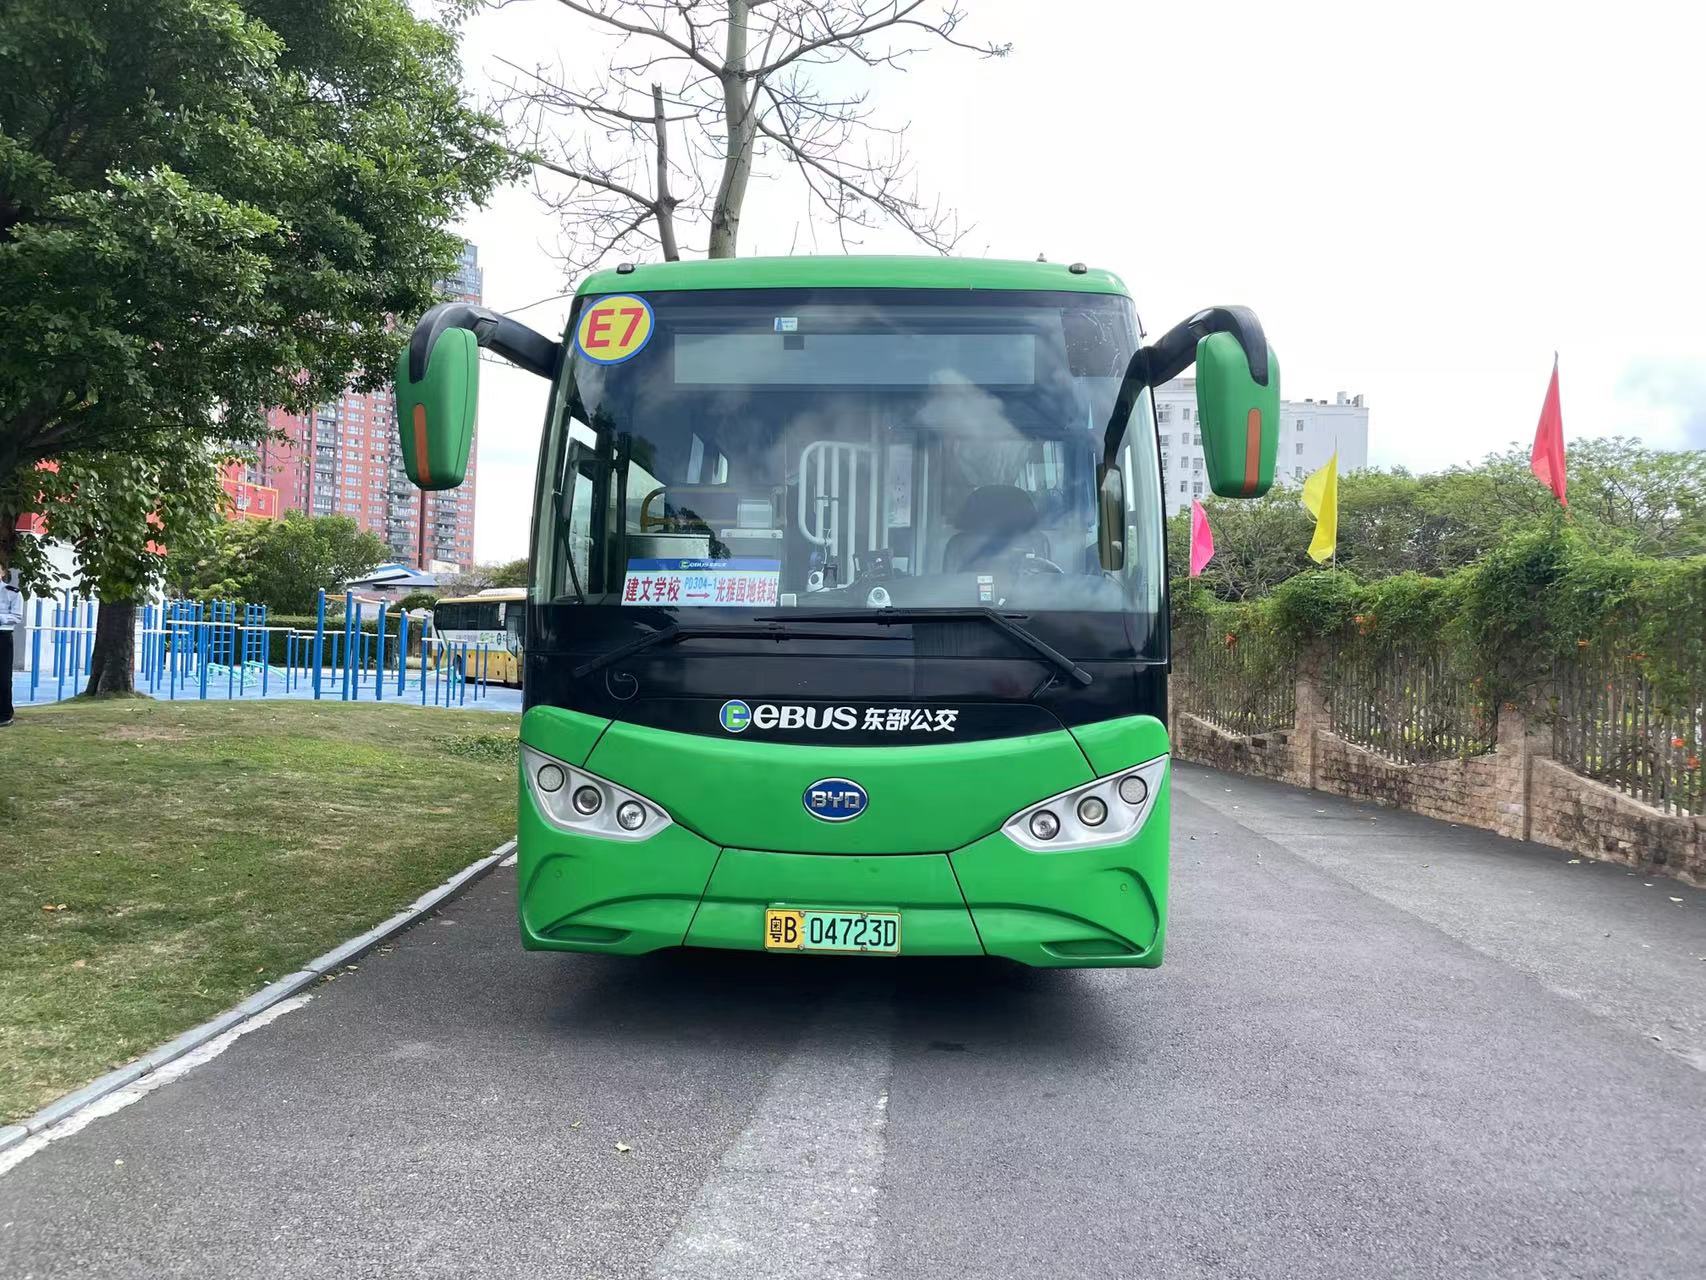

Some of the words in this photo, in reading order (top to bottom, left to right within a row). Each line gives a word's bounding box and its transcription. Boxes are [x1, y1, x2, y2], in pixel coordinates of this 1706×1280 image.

[585, 307, 644, 349] E7
[625, 577, 681, 602] 建文学校
[684, 577, 717, 590] PD304-1
[715, 578, 777, 603] 光雅园地铁站
[861, 708, 959, 732] 东部公交
[811, 790, 860, 809] BYD
